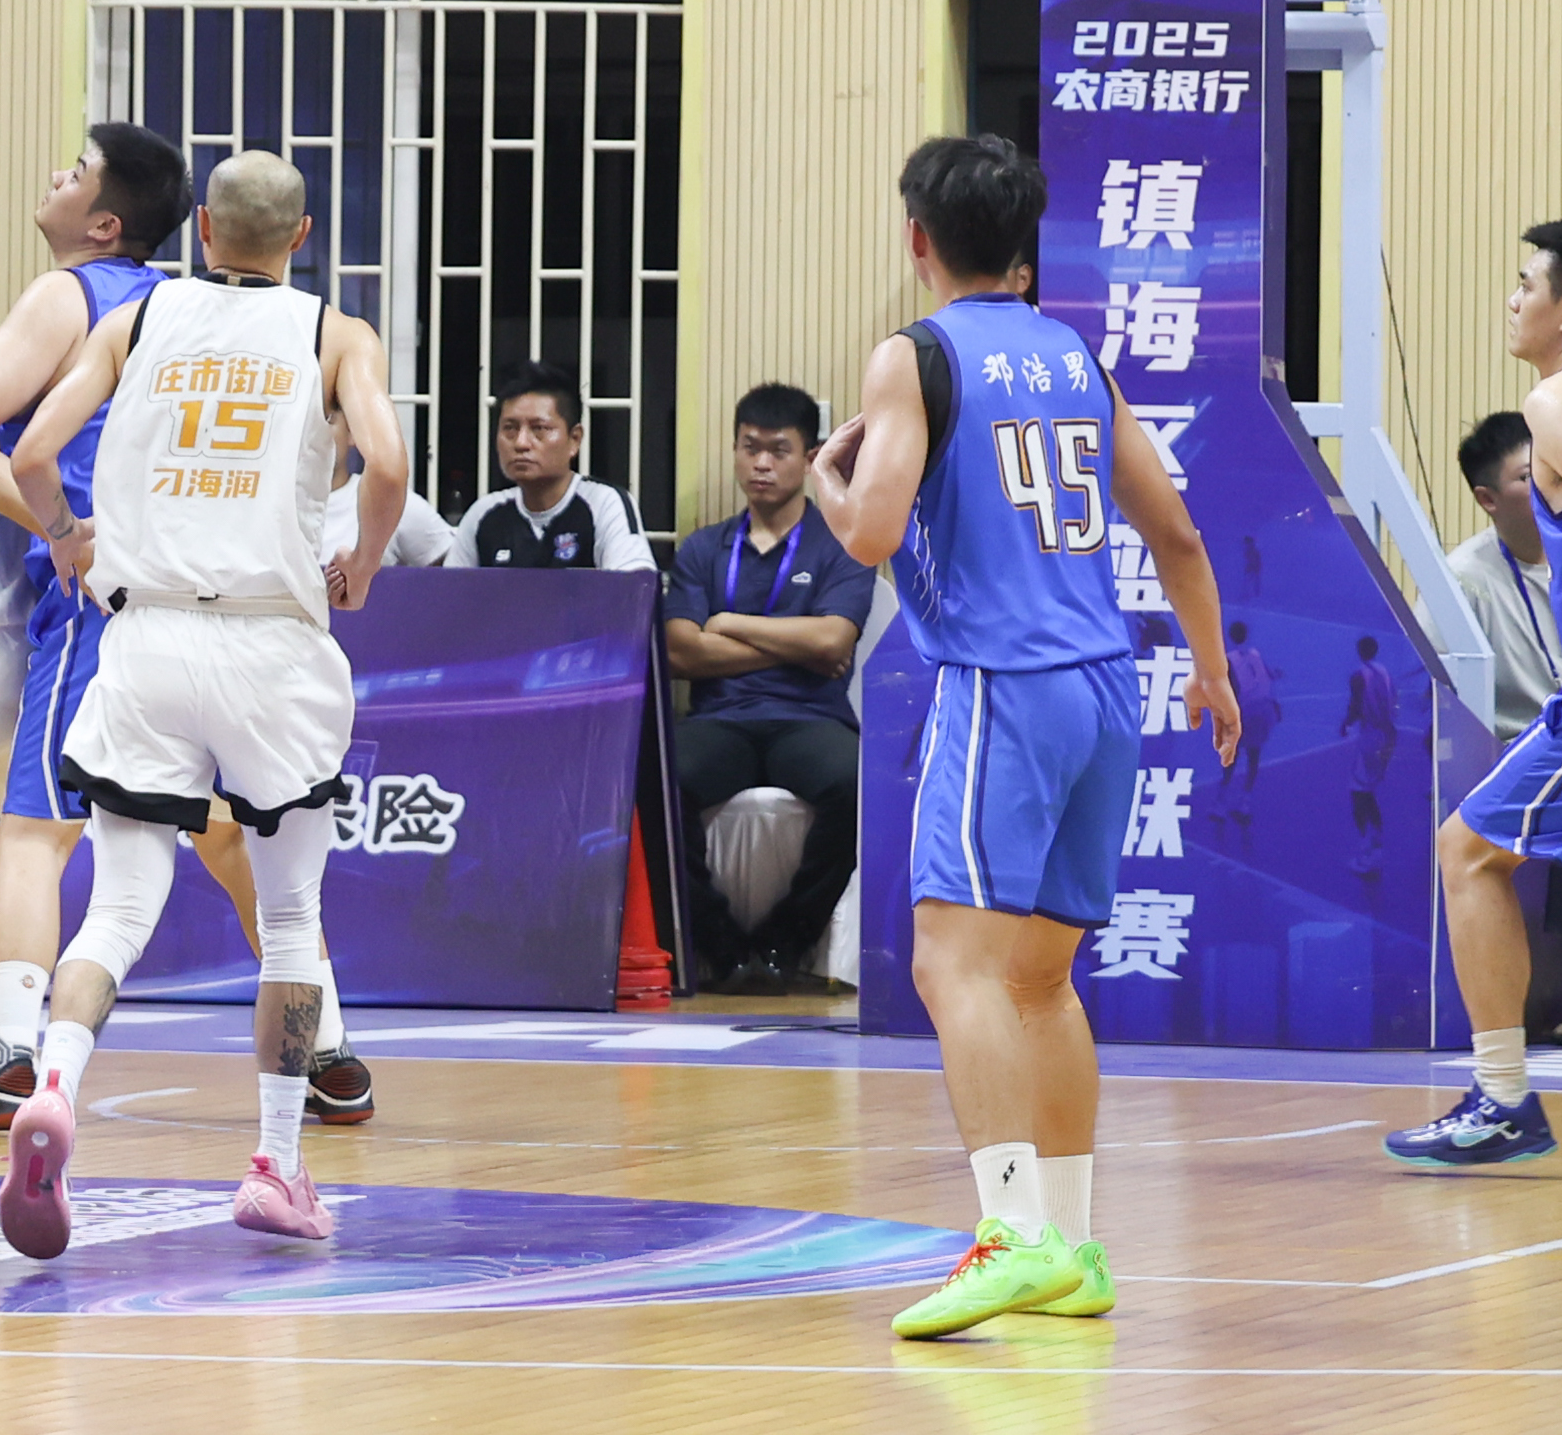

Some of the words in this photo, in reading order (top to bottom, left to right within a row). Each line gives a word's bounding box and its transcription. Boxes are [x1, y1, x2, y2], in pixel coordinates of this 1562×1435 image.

[1072, 20, 1231, 58] 2025
[1050, 67, 1251, 114] 农商银行
[153, 356, 296, 397] 庄市街道
[981, 350, 1090, 398] 邓浩男
[177, 399, 270, 452] 15
[990, 417, 1107, 555] 45
